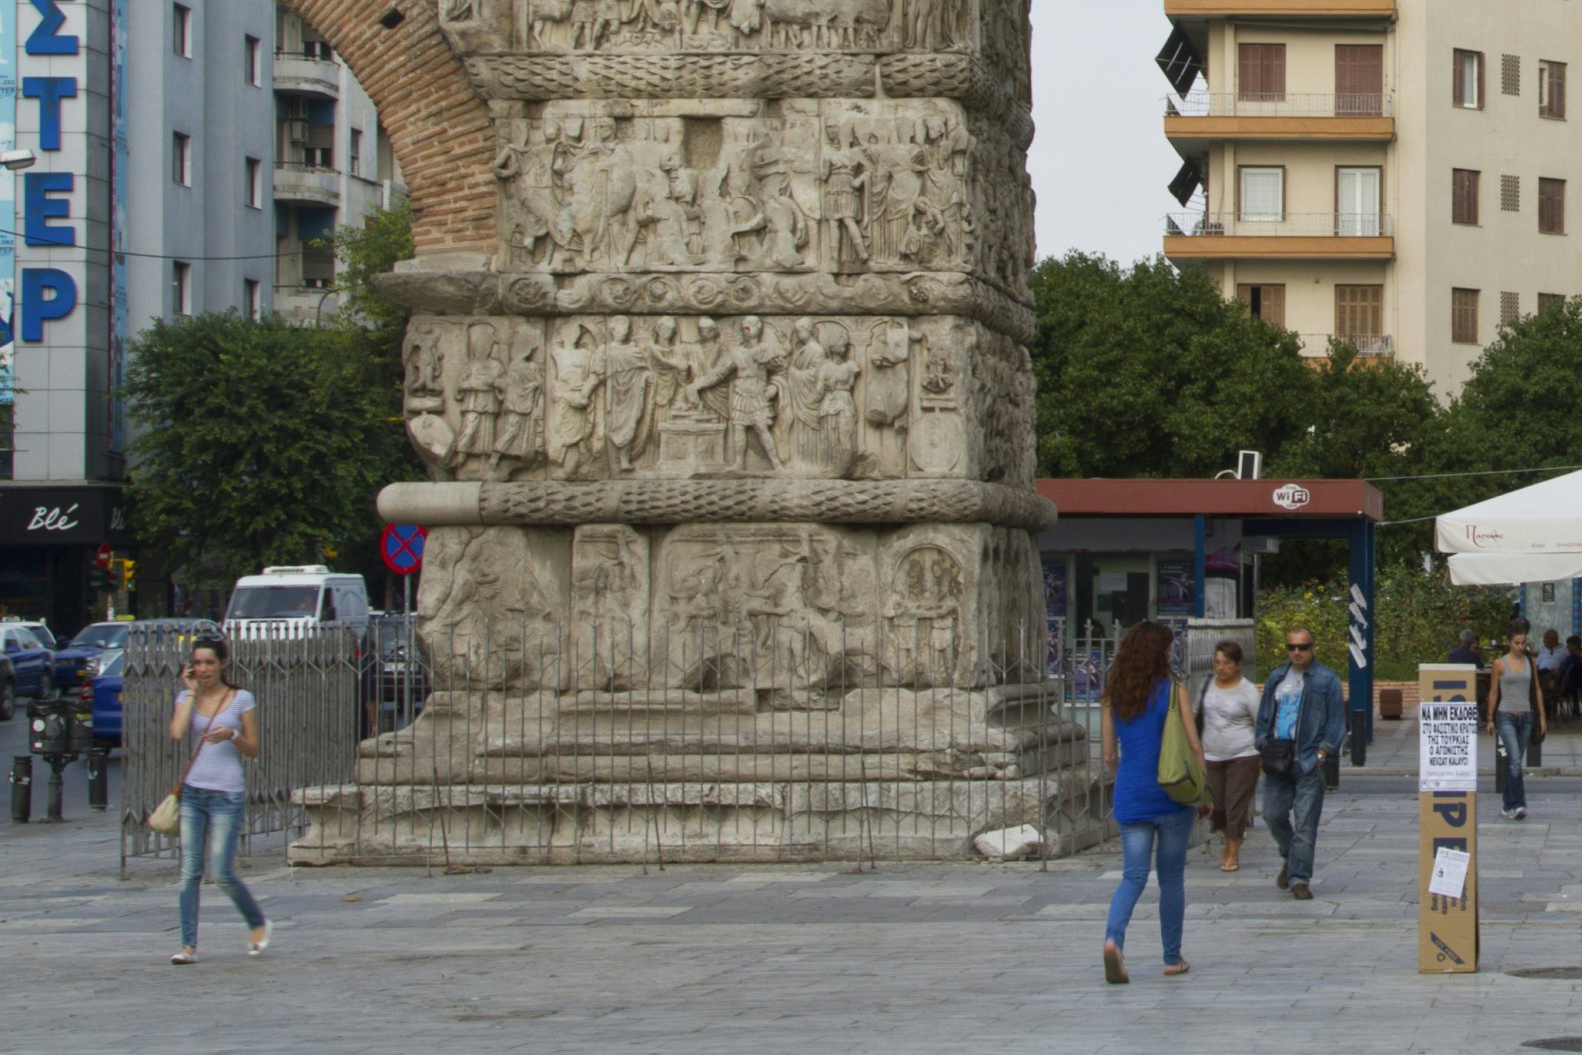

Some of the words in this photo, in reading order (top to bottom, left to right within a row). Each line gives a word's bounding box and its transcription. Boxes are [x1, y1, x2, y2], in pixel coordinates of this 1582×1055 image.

[27, 503, 79, 530] Blé
[1422, 707, 1431, 720] ΝΑ
[1433, 707, 1448, 720] ΜΗΝ
[1428, 735, 1439, 744] ΤΗΣ
[1441, 735, 1470, 744] ΤΟΥΡΚΙΑΣ
